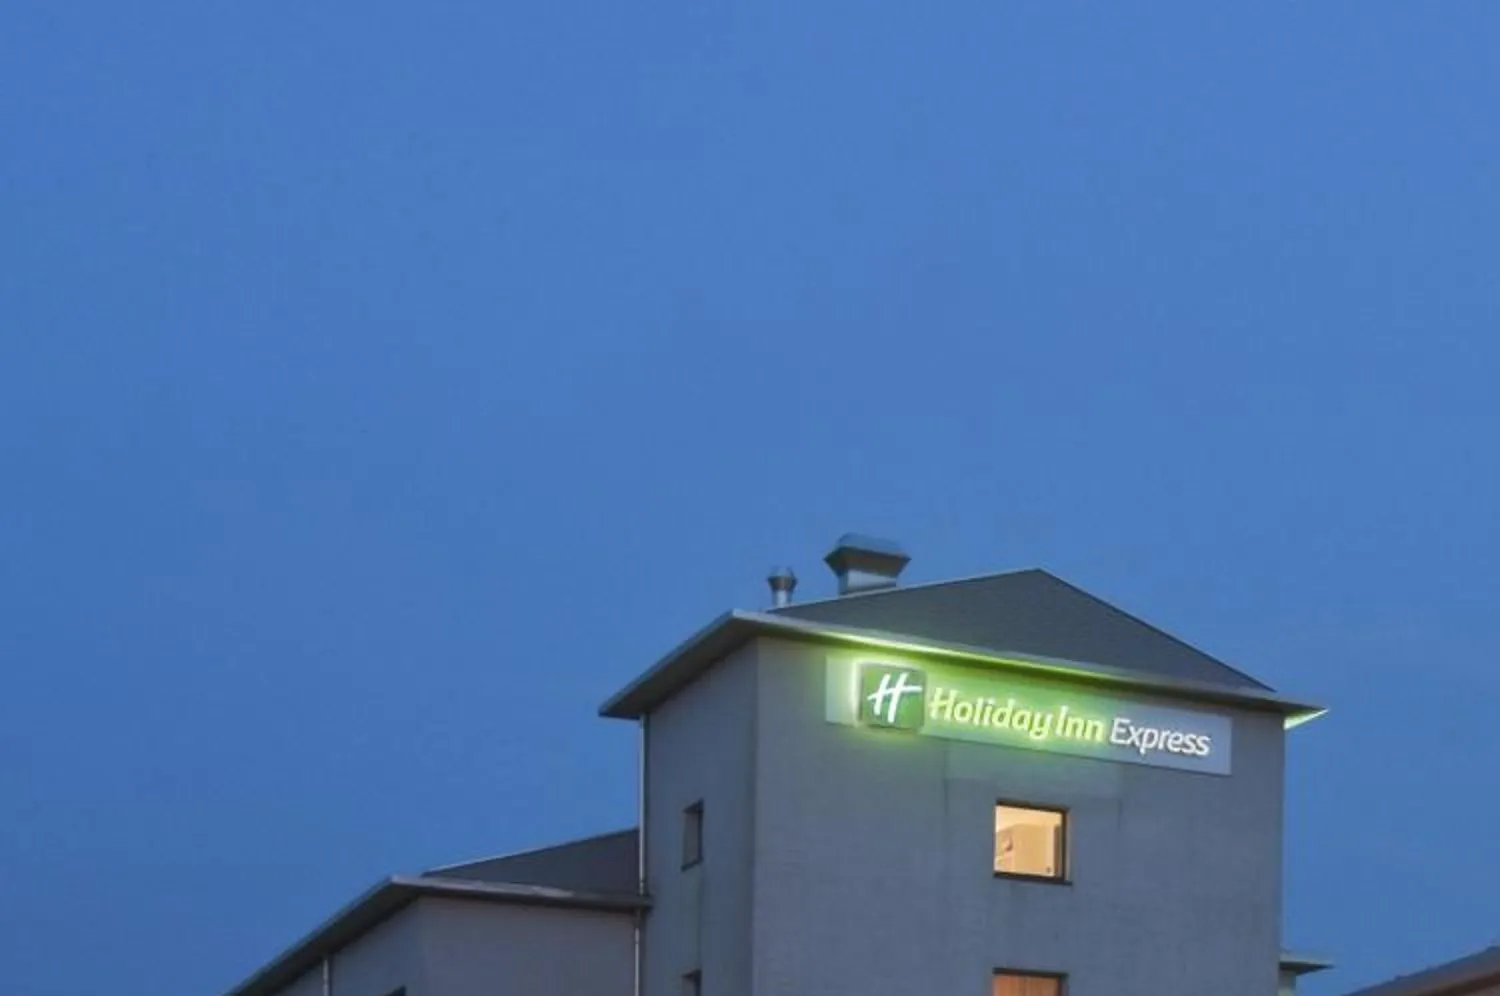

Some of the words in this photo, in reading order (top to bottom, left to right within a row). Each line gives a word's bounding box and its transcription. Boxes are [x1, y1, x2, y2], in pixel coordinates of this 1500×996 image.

[929, 687, 1052, 740] Holiday
[1056, 706, 1103, 741] Inn
[1110, 717, 1210, 757] Express
